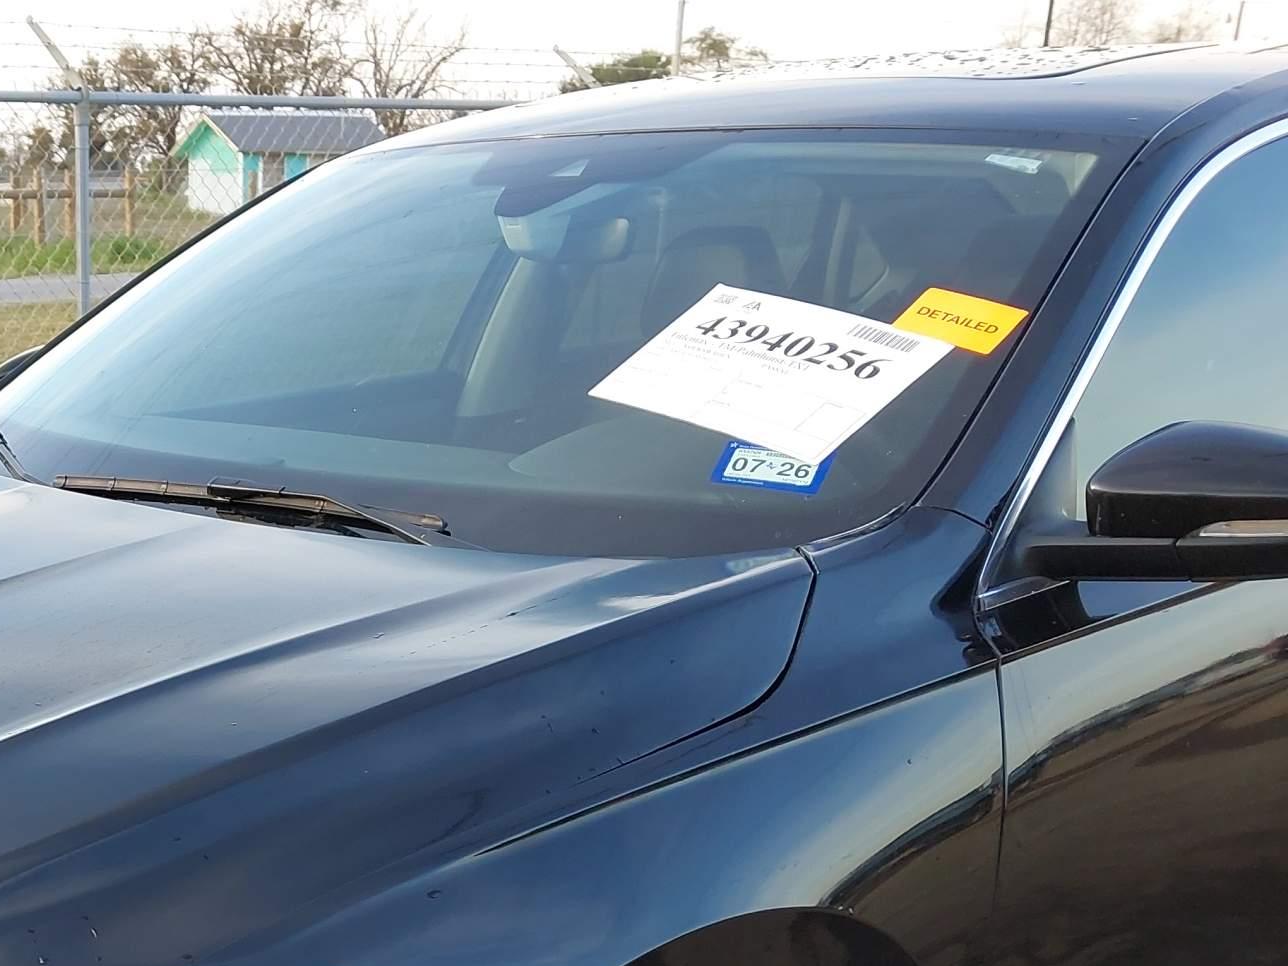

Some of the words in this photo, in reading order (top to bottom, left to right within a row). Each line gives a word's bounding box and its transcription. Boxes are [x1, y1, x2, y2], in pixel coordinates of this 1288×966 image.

[916, 306, 999, 334] DETAILED
[695, 316, 894, 379] 43940256
[731, 457, 766, 473] 07
[775, 462, 812, 478] 26
